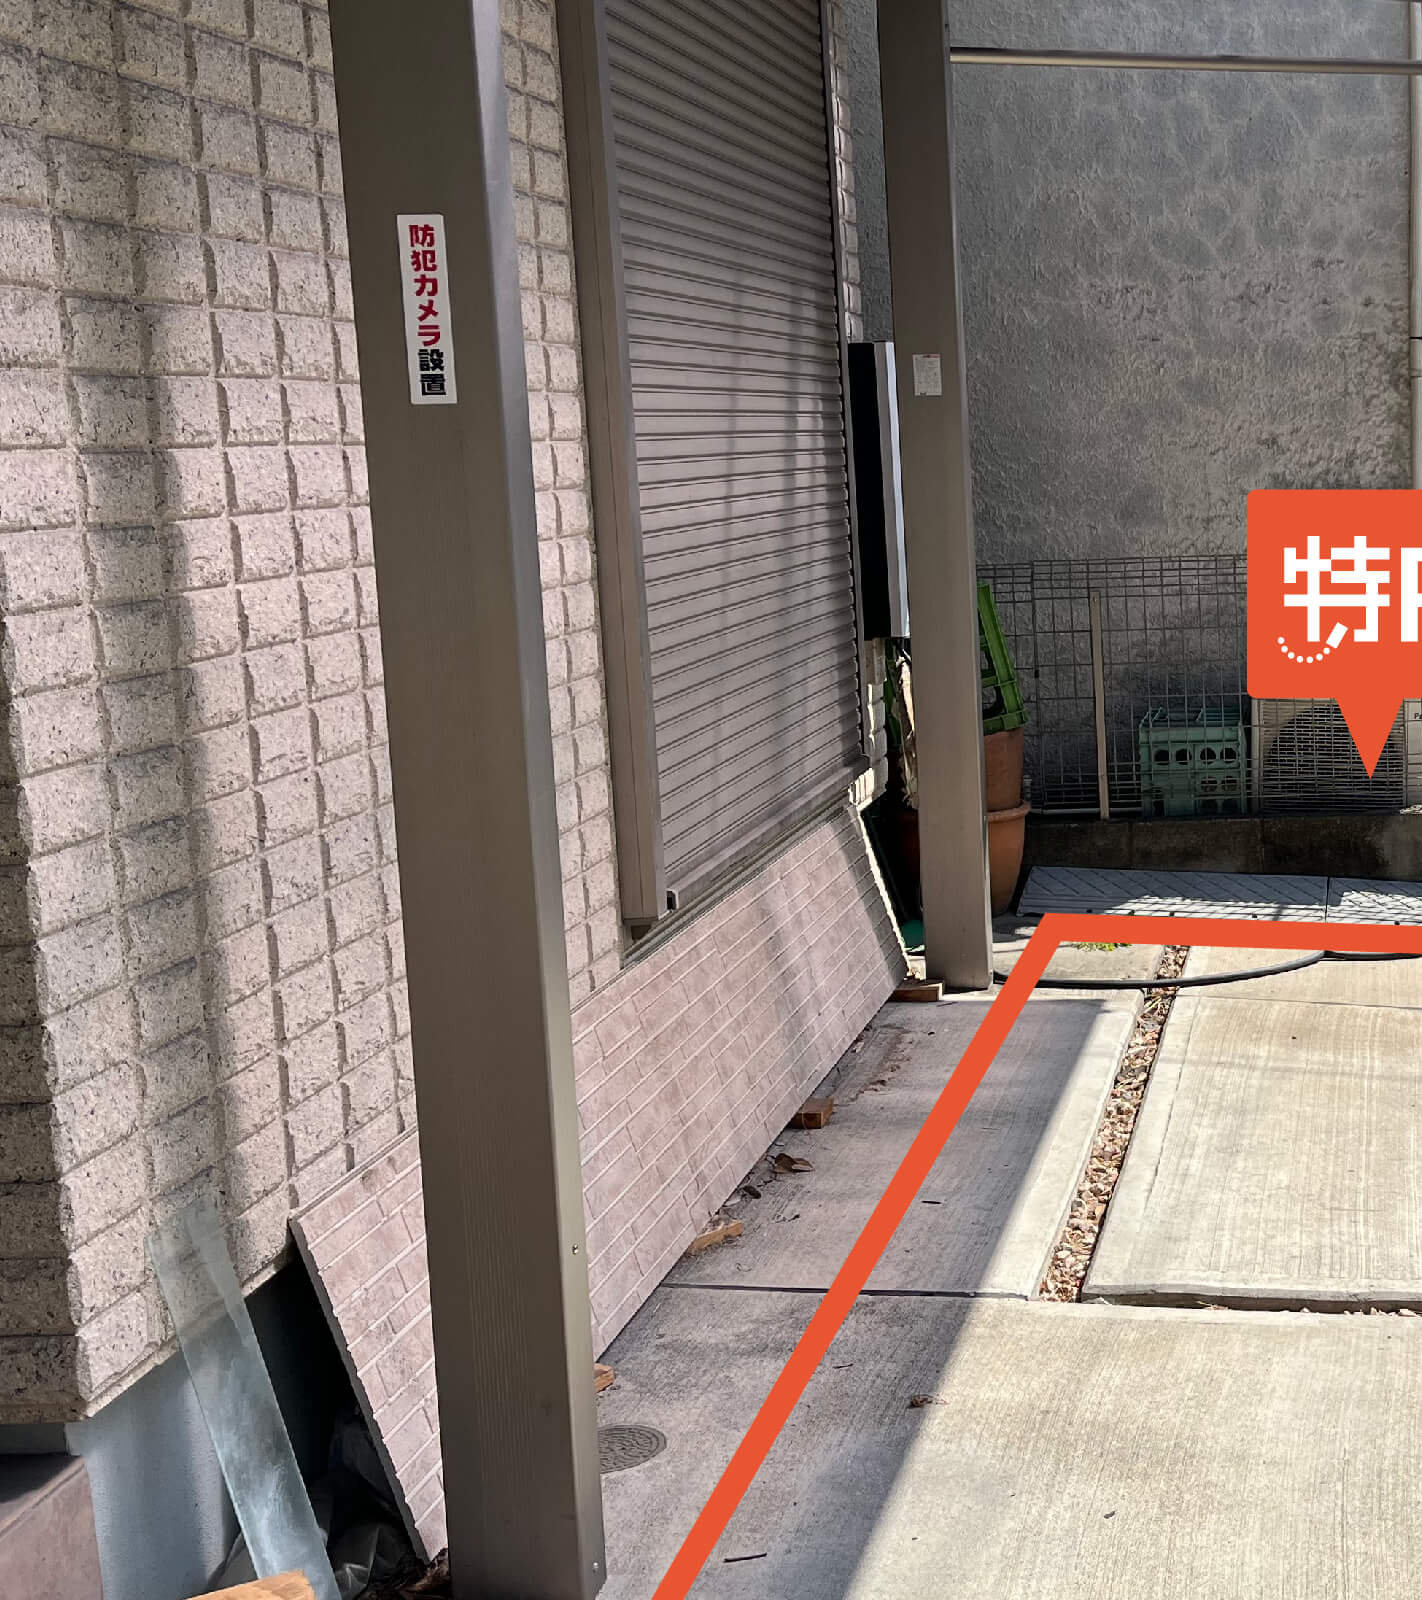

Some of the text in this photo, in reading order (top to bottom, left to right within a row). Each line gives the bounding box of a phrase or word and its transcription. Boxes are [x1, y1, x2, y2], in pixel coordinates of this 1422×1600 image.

[408, 224, 447, 396] 防犯カメラ設置
